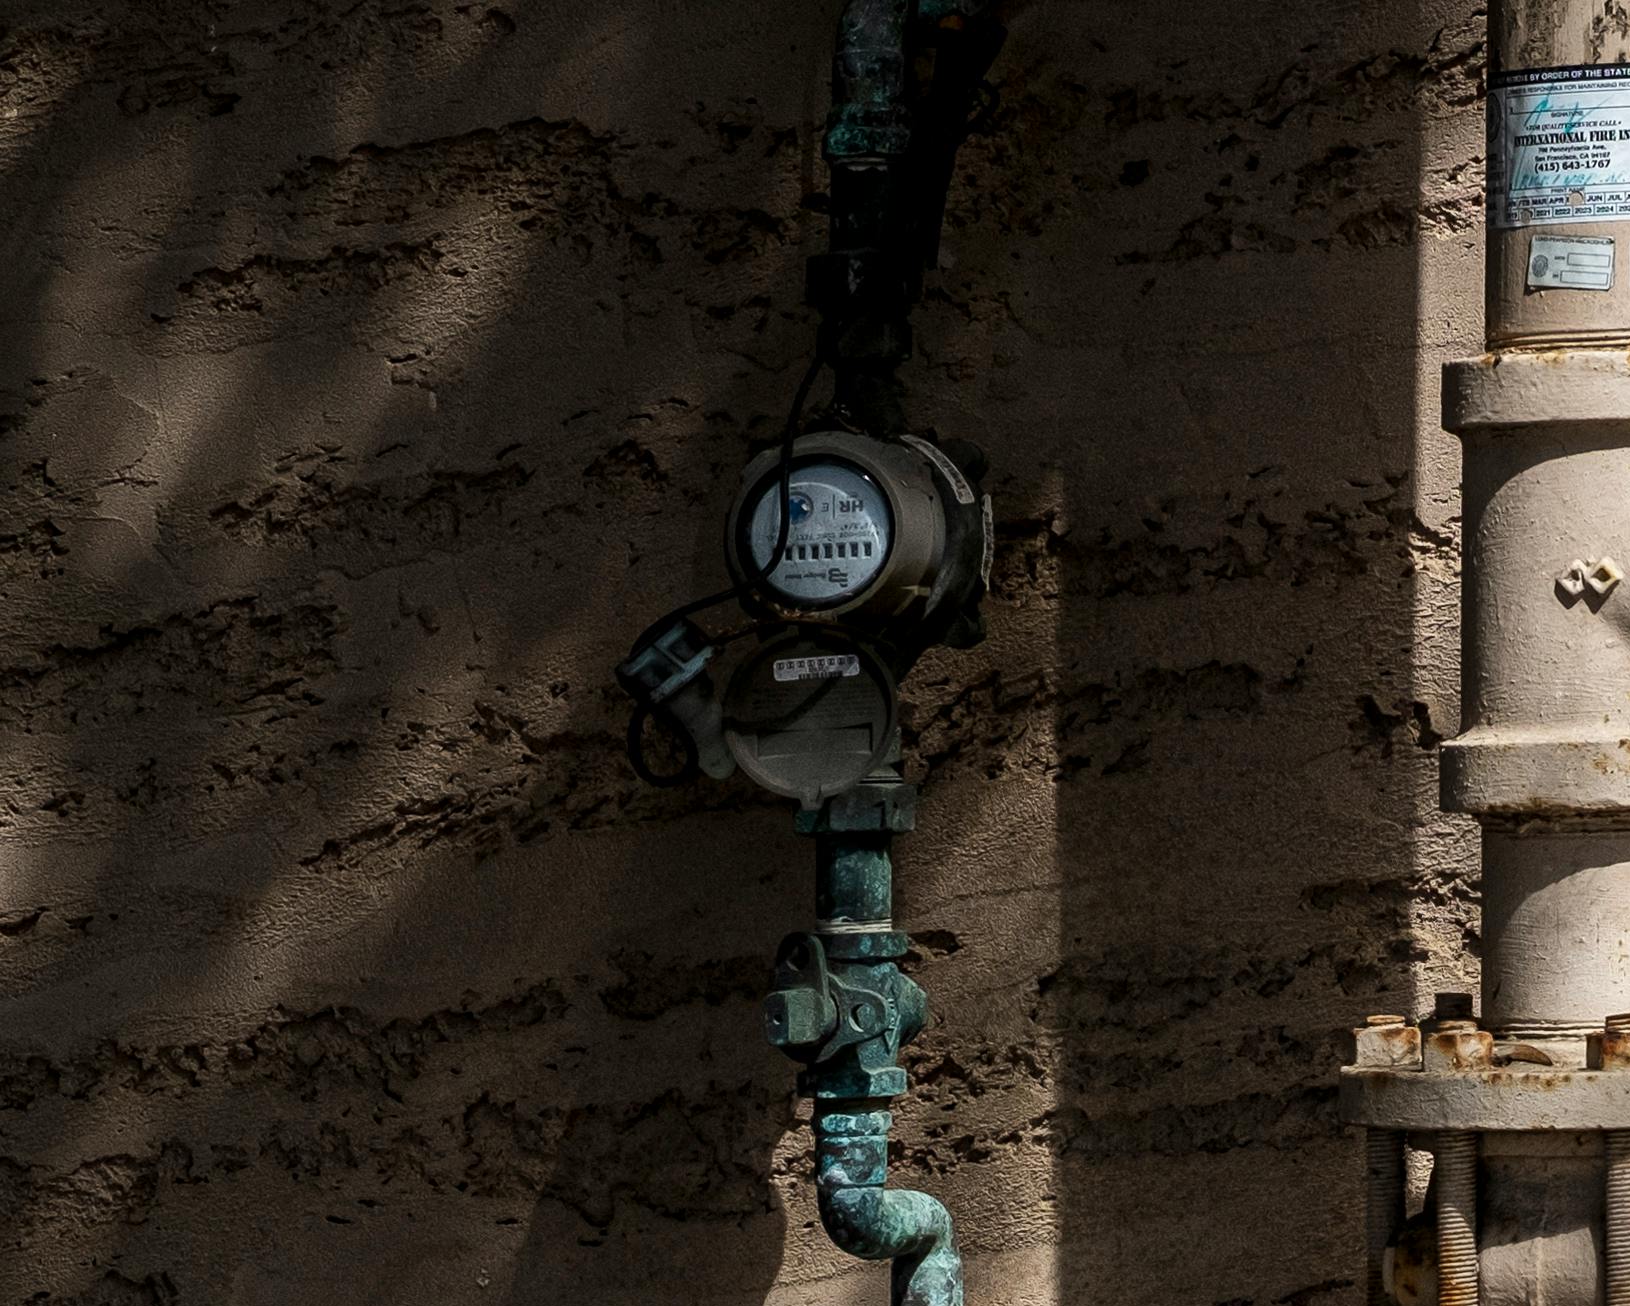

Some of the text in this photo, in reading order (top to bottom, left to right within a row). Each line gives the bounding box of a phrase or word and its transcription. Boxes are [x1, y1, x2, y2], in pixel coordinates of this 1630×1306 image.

[1529, 73, 1540, 81] BY
[1541, 71, 1569, 80] ORDER
[1571, 70, 1583, 78] OF
[1584, 69, 1603, 77] THE
[1550, 110, 1584, 118] SIGNATURE
[1589, 129, 1616, 142] FIRE
[1534, 159, 1611, 174] (415) 643-1767
[1531, 197, 1548, 205] MAR
[1549, 196, 1564, 204] APR
[1608, 193, 1623, 201] JUL
[838, 499, 862, 512] HR
